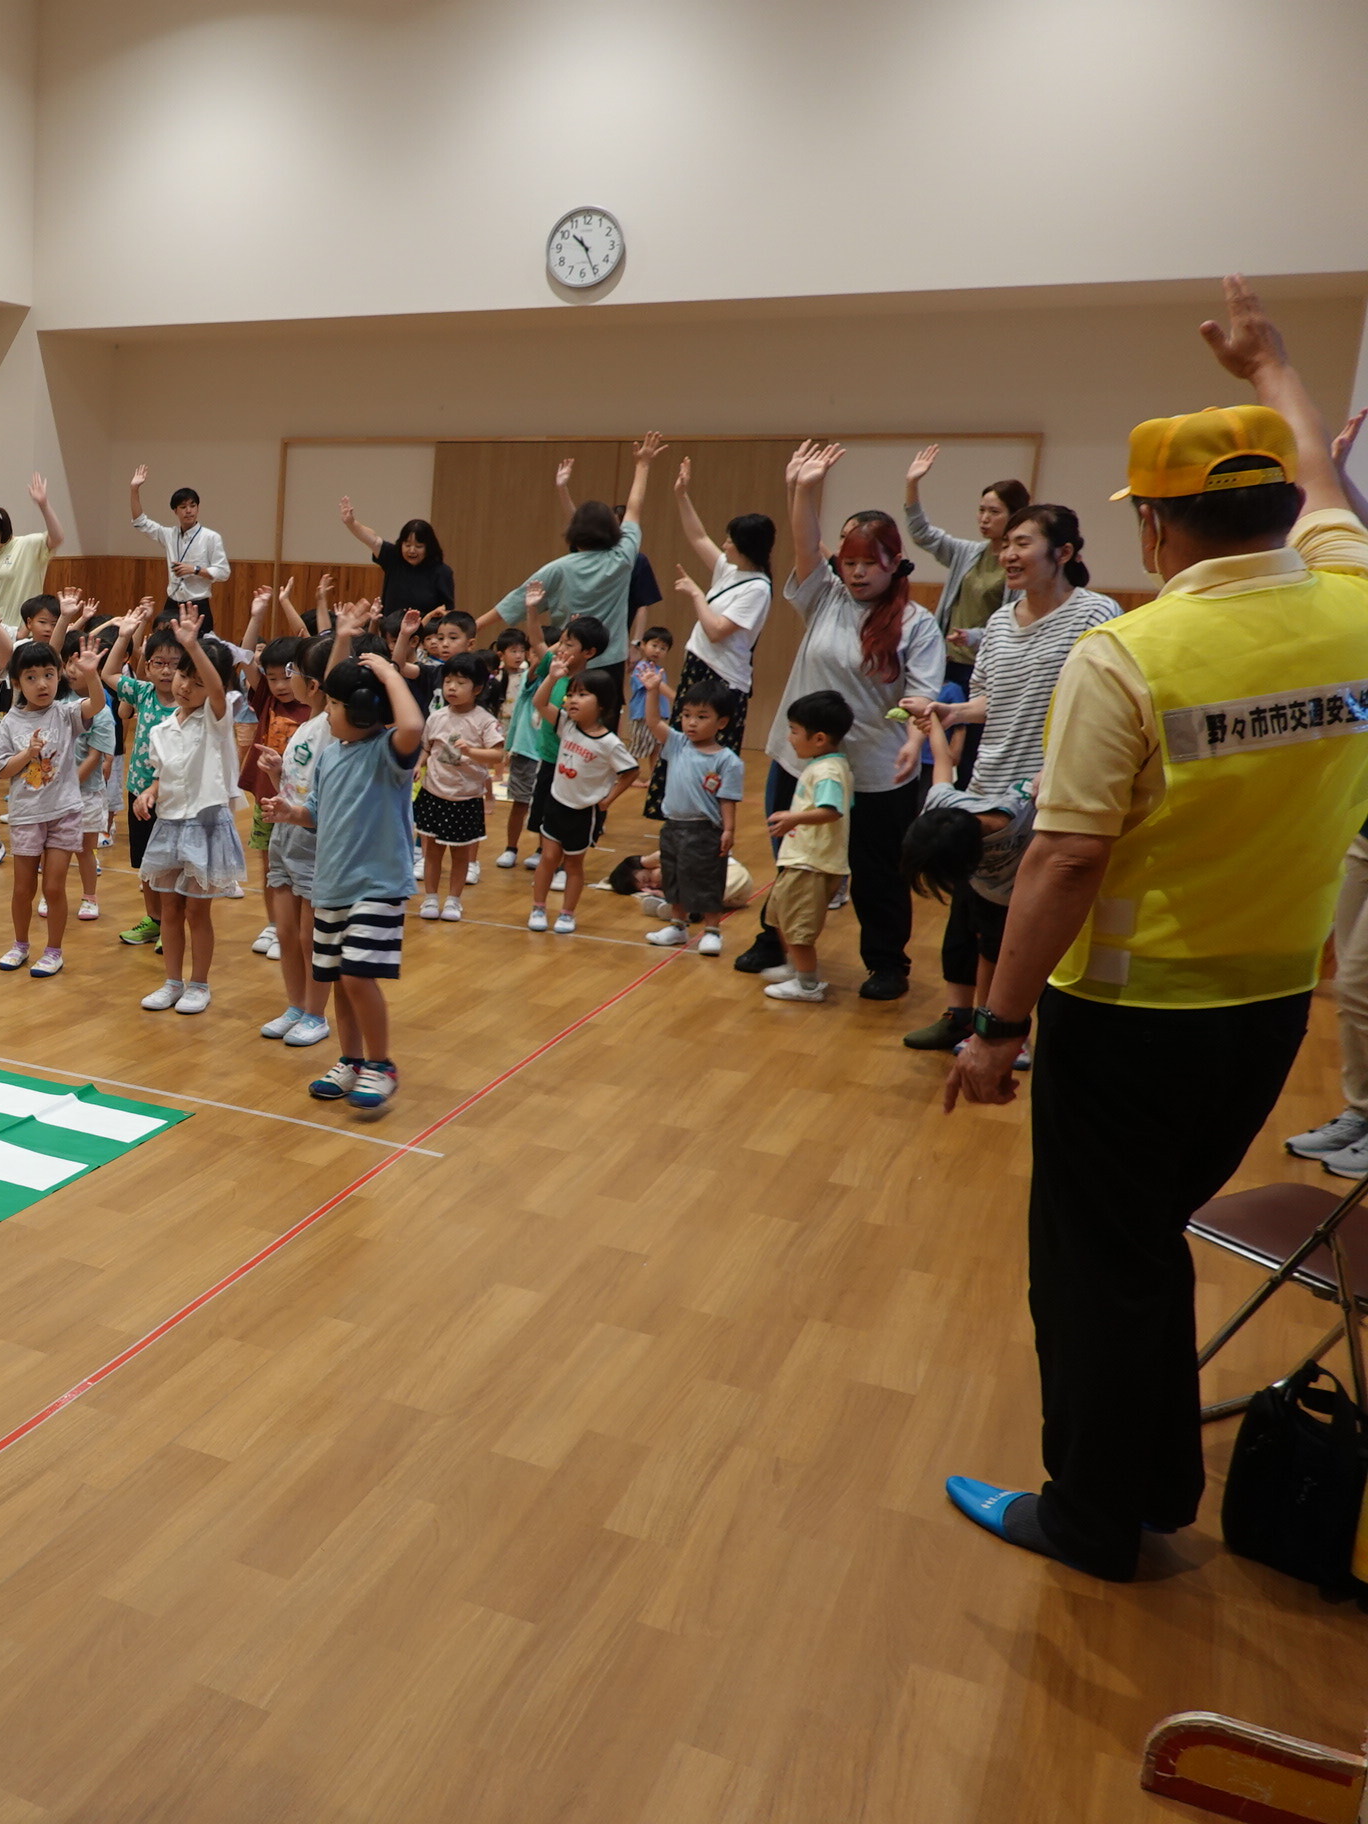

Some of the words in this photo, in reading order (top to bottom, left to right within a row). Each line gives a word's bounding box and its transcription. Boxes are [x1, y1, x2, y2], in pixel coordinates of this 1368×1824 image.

[571, 219, 578, 229] 11
[583, 215, 592, 225] 12
[560, 230, 570, 240] 10
[605, 226, 612, 237] 2
[556, 243, 562, 253] 9
[608, 240, 615, 250] 3
[558, 256, 565, 267] 8
[602, 254, 609, 264] 4
[568, 265, 574, 275] 7
[579, 268, 586, 278] 6
